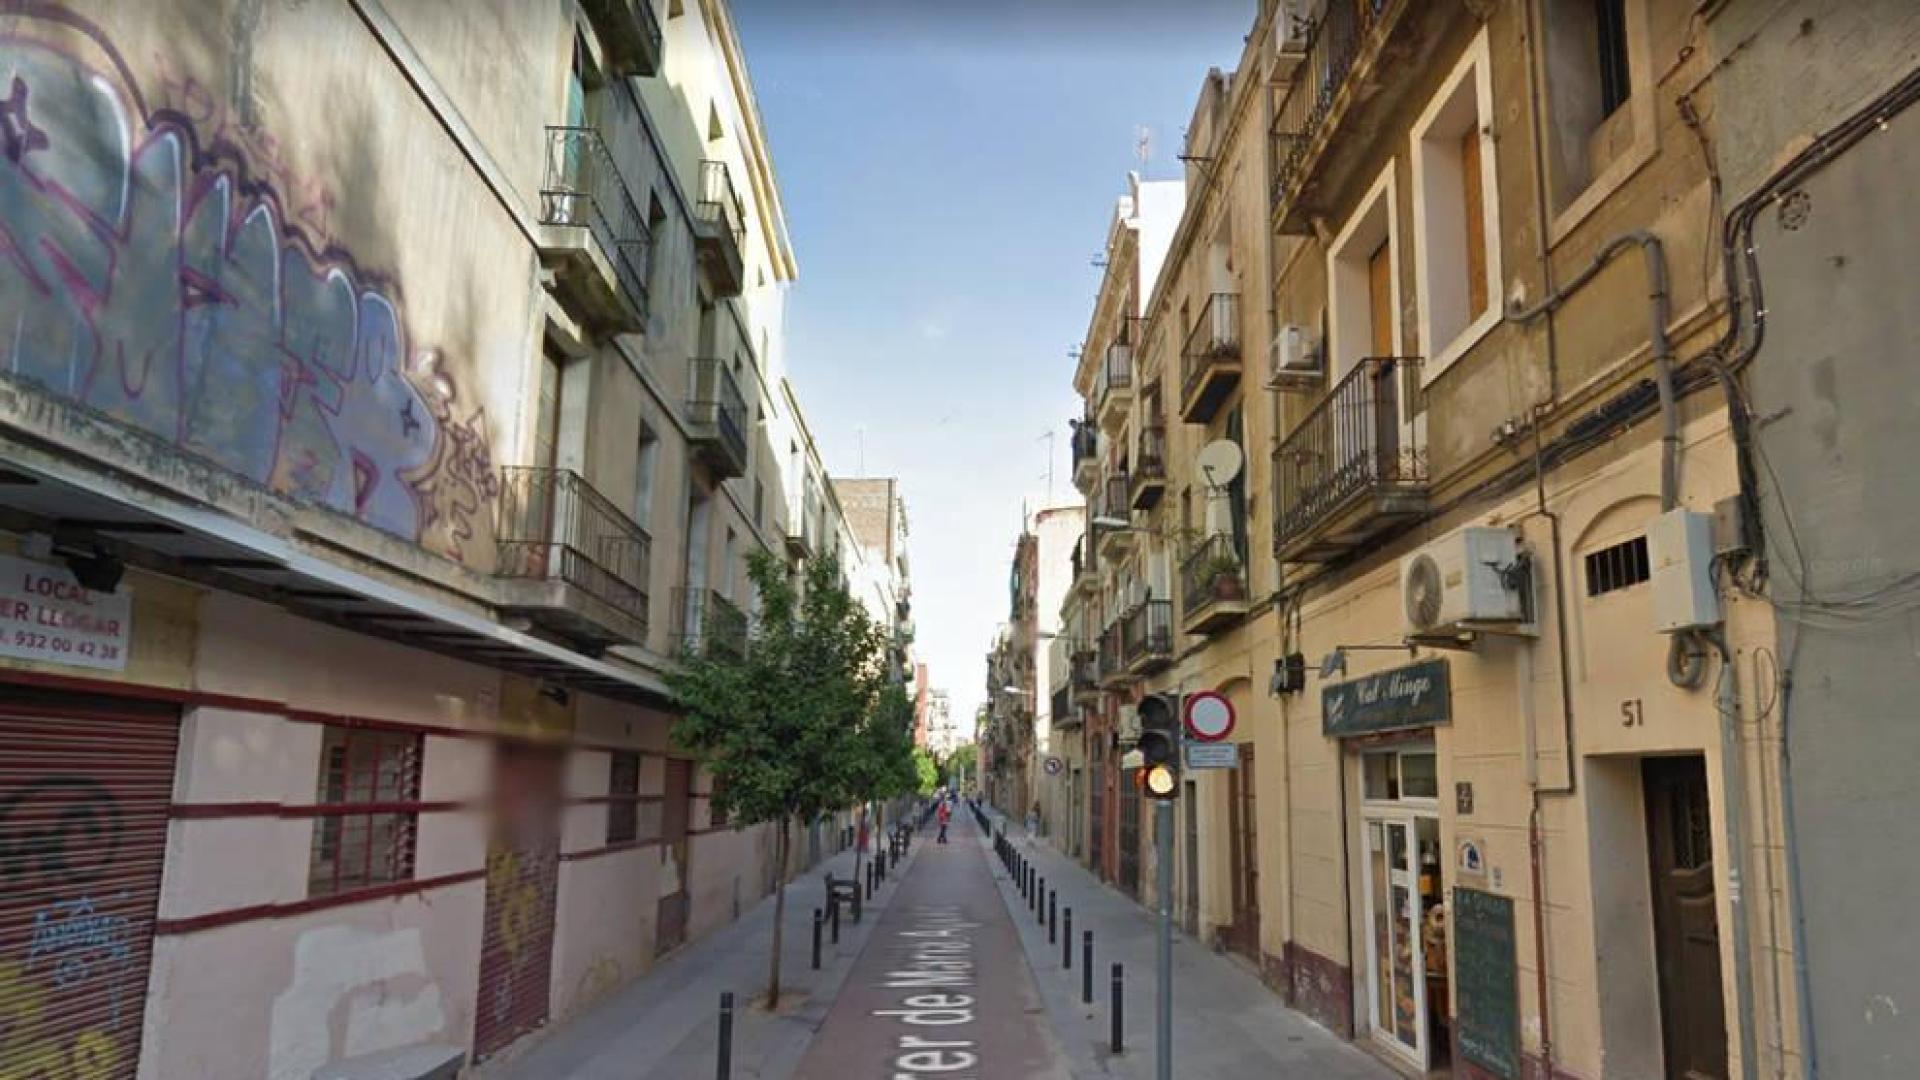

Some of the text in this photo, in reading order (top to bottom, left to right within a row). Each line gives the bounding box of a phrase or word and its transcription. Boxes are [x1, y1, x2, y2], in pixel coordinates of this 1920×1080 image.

[24, 573, 94, 606] LOCAL
[36, 605, 121, 637] LLOGAR
[15, 630, 48, 648] 932
[51, 637, 73, 653] 00
[77, 641, 96, 657] 42
[1620, 697, 1644, 726] 51
